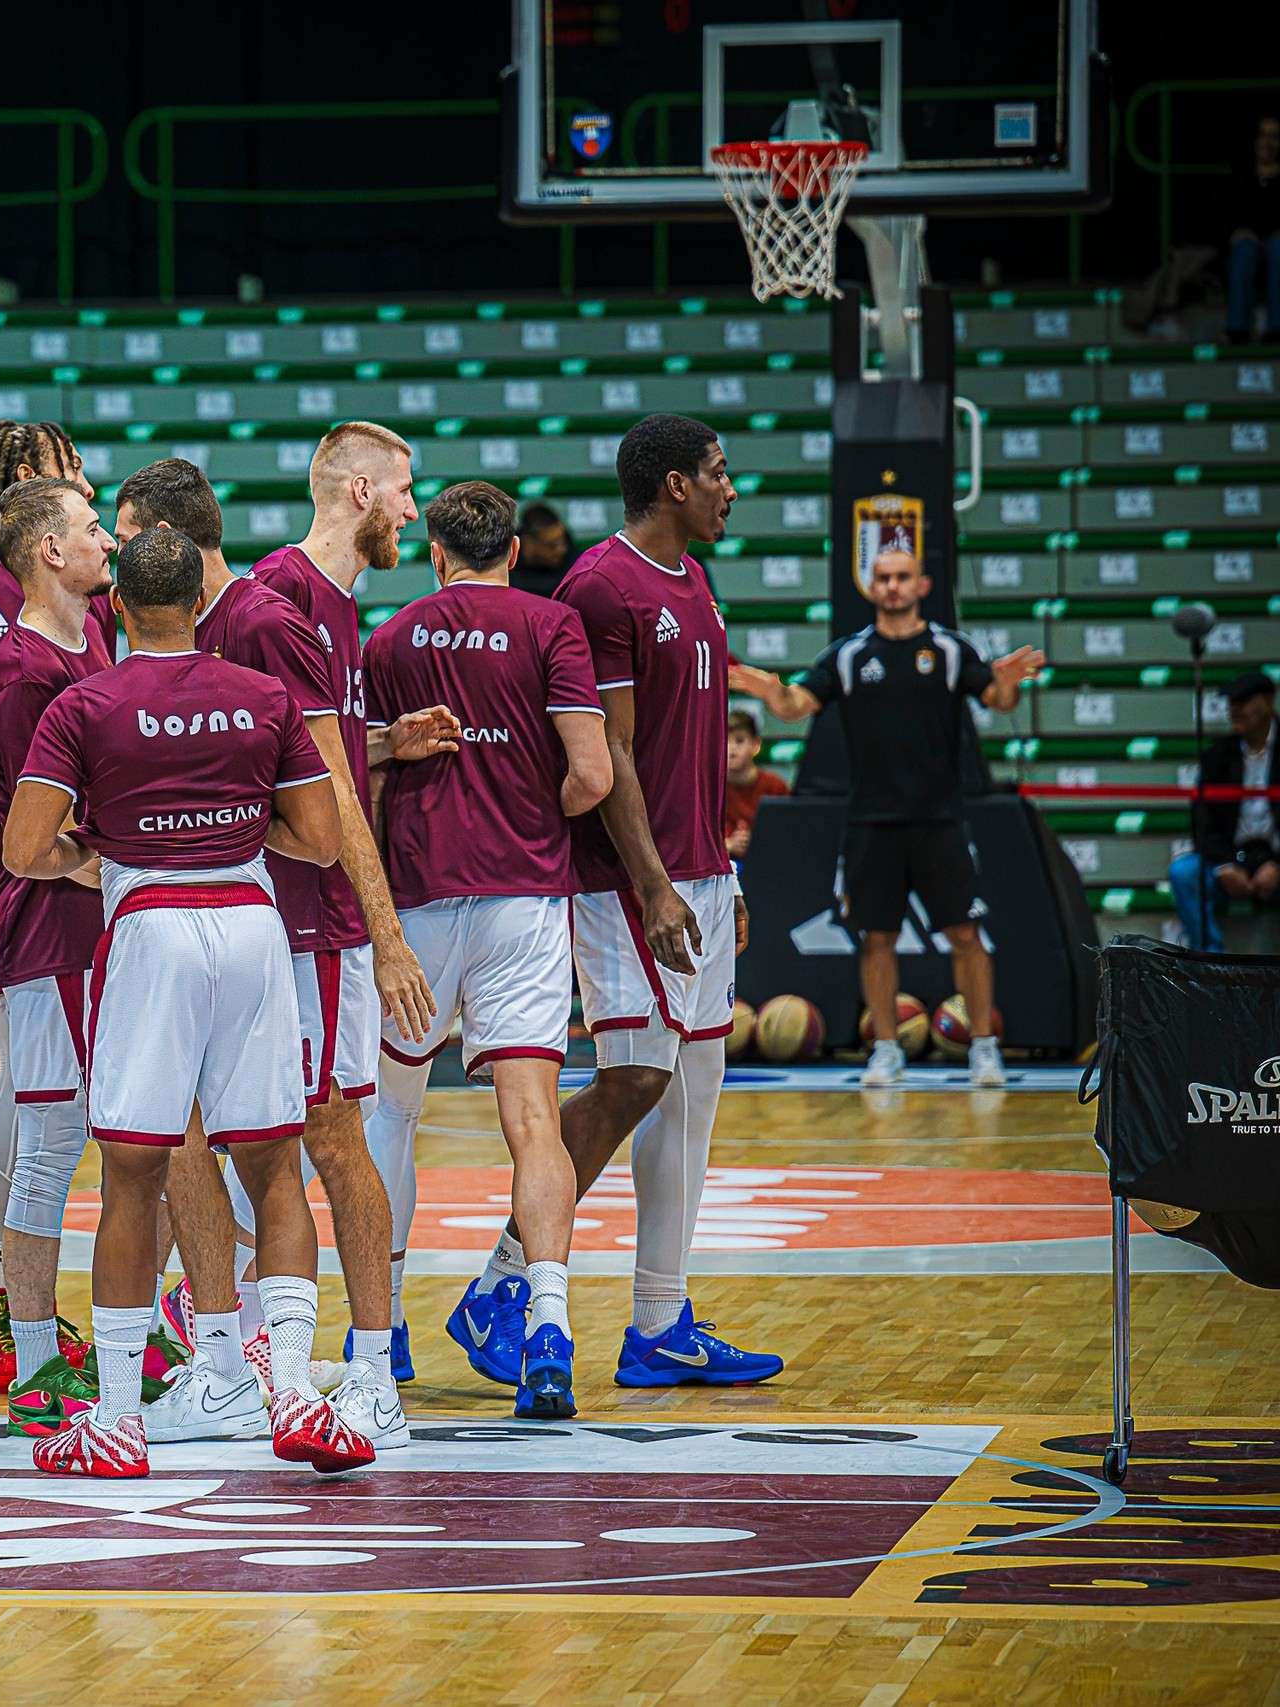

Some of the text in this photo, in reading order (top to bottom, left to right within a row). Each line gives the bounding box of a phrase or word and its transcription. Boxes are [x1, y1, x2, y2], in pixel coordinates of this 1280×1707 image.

[411, 623, 509, 652] bosna
[695, 640, 711, 690] 11
[136, 708, 255, 738] bosna
[138, 803, 262, 832] CHANGAN
[1187, 1082, 1280, 1124] SPAL
[1231, 1125, 1257, 1134] TRUE
[1258, 1125, 1271, 1134] TO
